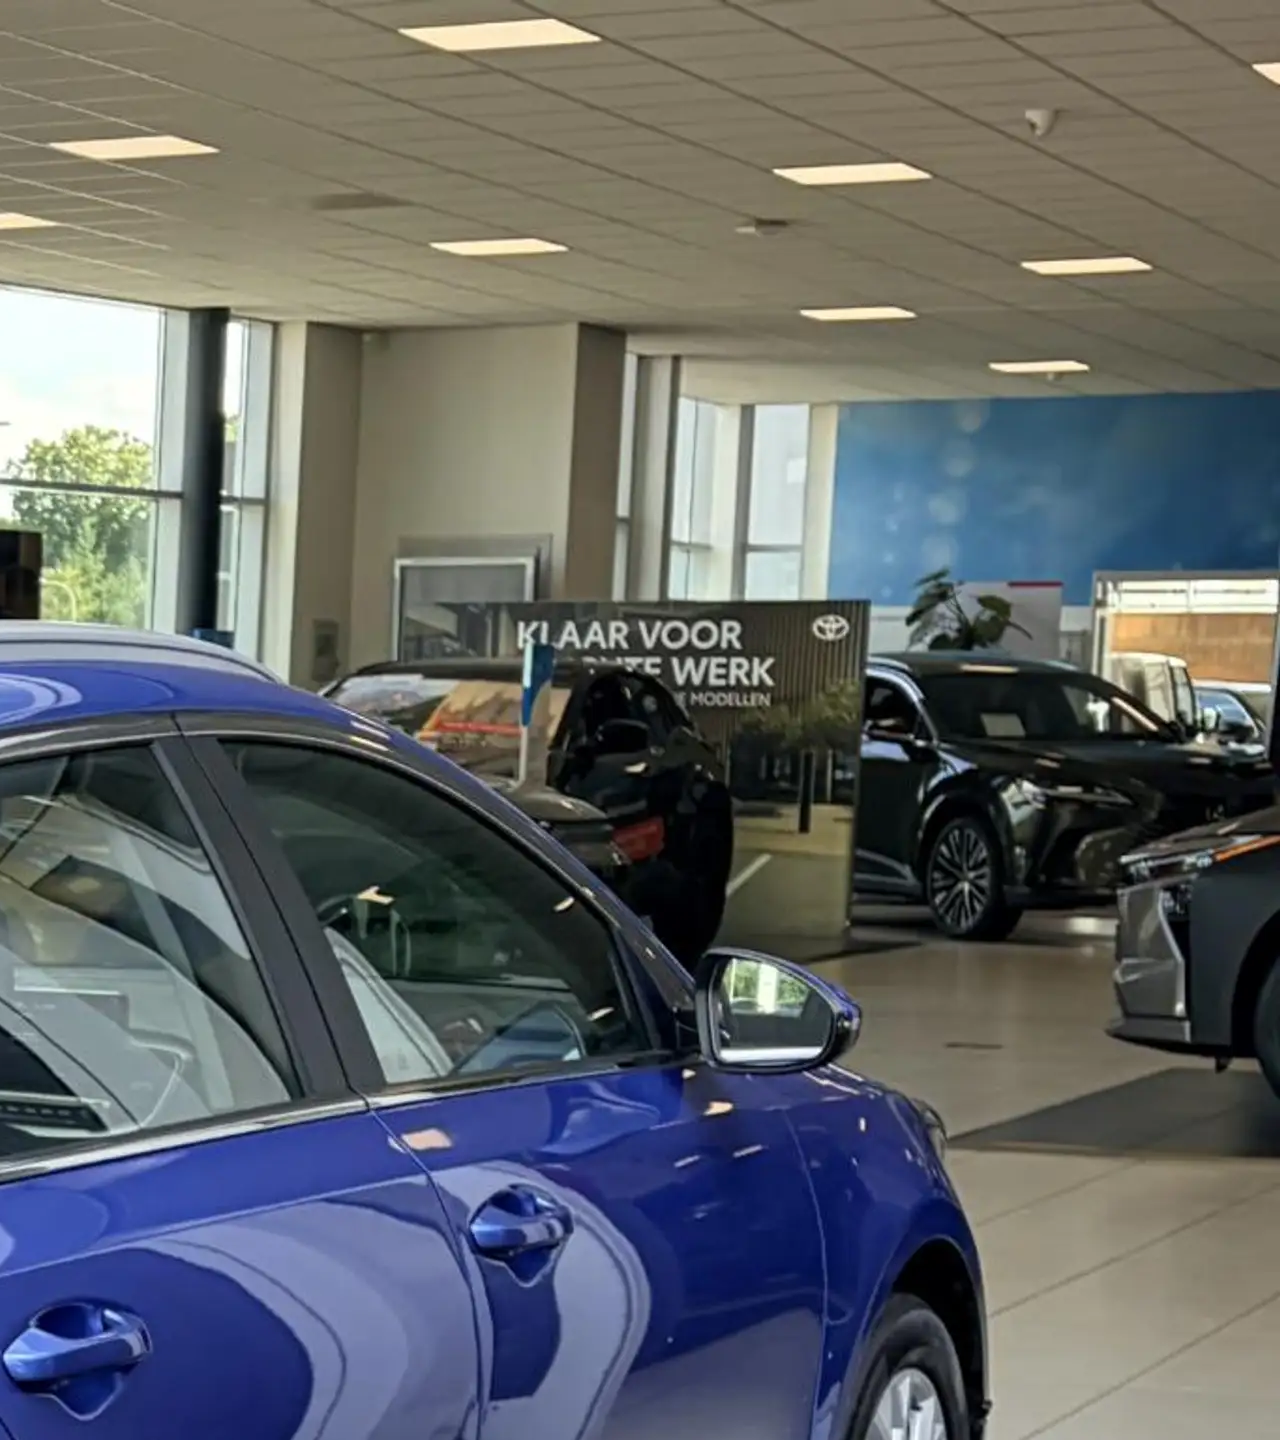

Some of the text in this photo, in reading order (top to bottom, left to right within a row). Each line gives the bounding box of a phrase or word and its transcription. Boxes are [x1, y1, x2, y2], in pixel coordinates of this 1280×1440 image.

[517, 620, 742, 650] KLAAR VOOR
[671, 656, 775, 687] WERK
[690, 692, 771, 707] MODELLEN
